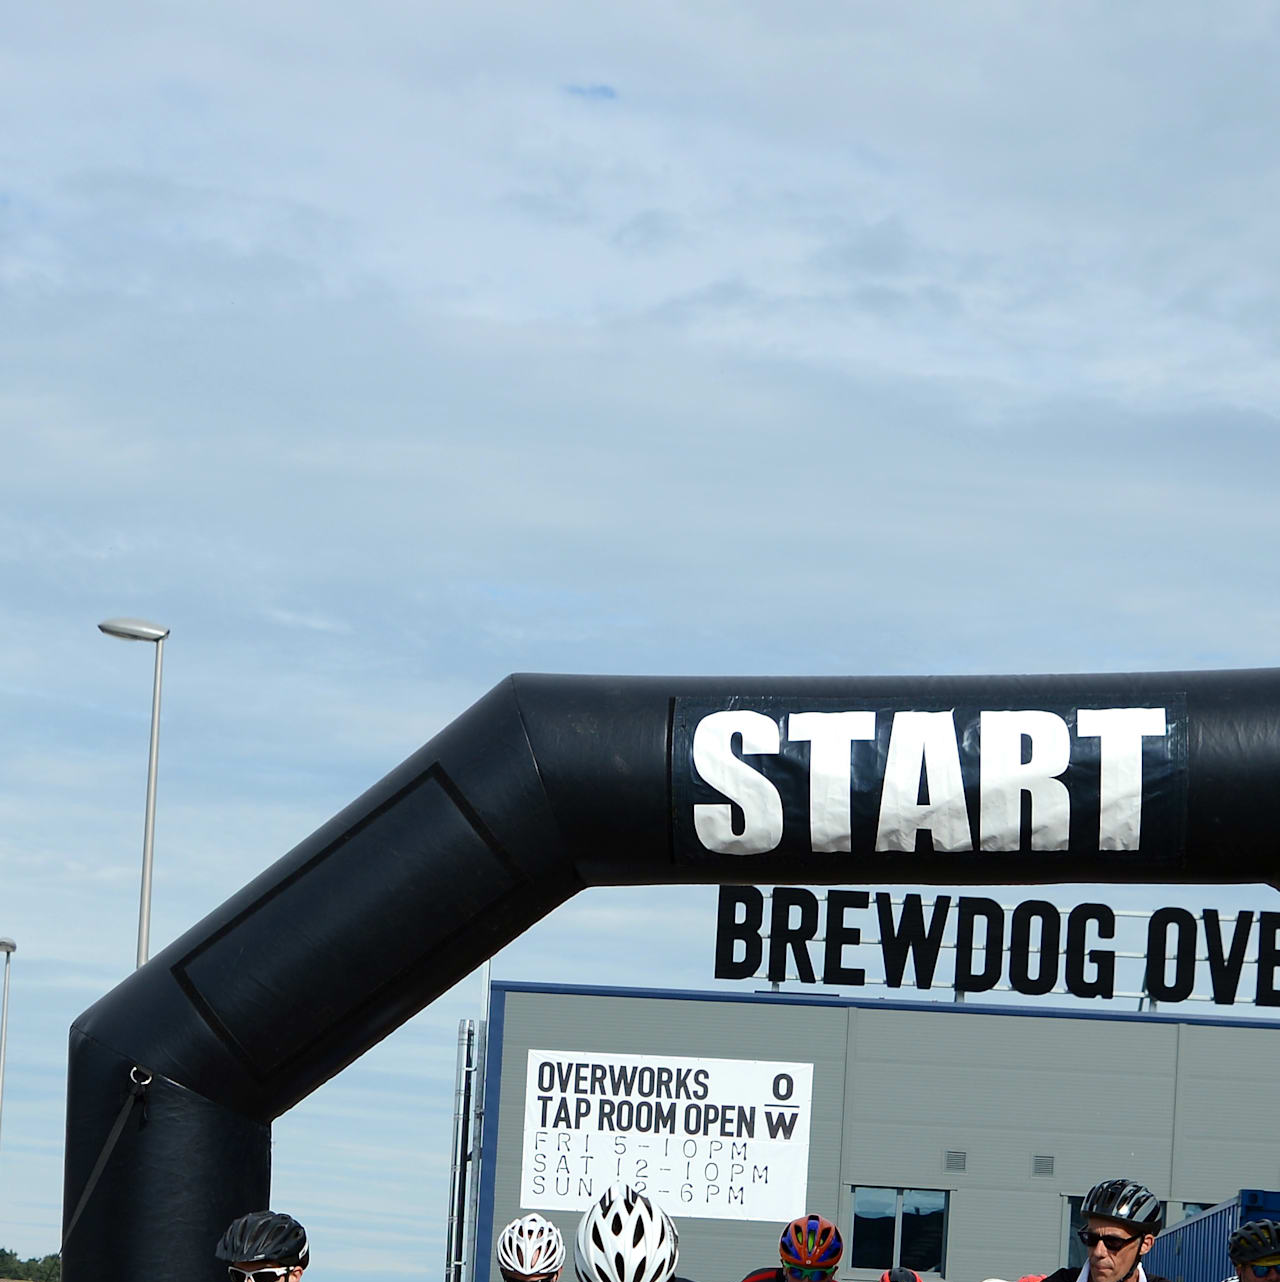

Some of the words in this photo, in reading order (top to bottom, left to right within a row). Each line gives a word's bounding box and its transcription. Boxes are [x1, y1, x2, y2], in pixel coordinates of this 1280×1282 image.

[692, 706, 1167, 856] START
[714, 884, 1116, 1000] BREWDOG
[537, 1061, 710, 1101] OVERWORKS
[772, 1073, 794, 1101] O
[537, 1095, 591, 1130] TAP
[597, 1099, 677, 1135] ROOM
[683, 1103, 756, 1139] OPEN
[764, 1111, 799, 1140] W
[534, 1131, 590, 1152] FRI
[533, 1153, 594, 1175] SAT
[532, 1175, 593, 1197] SUN
